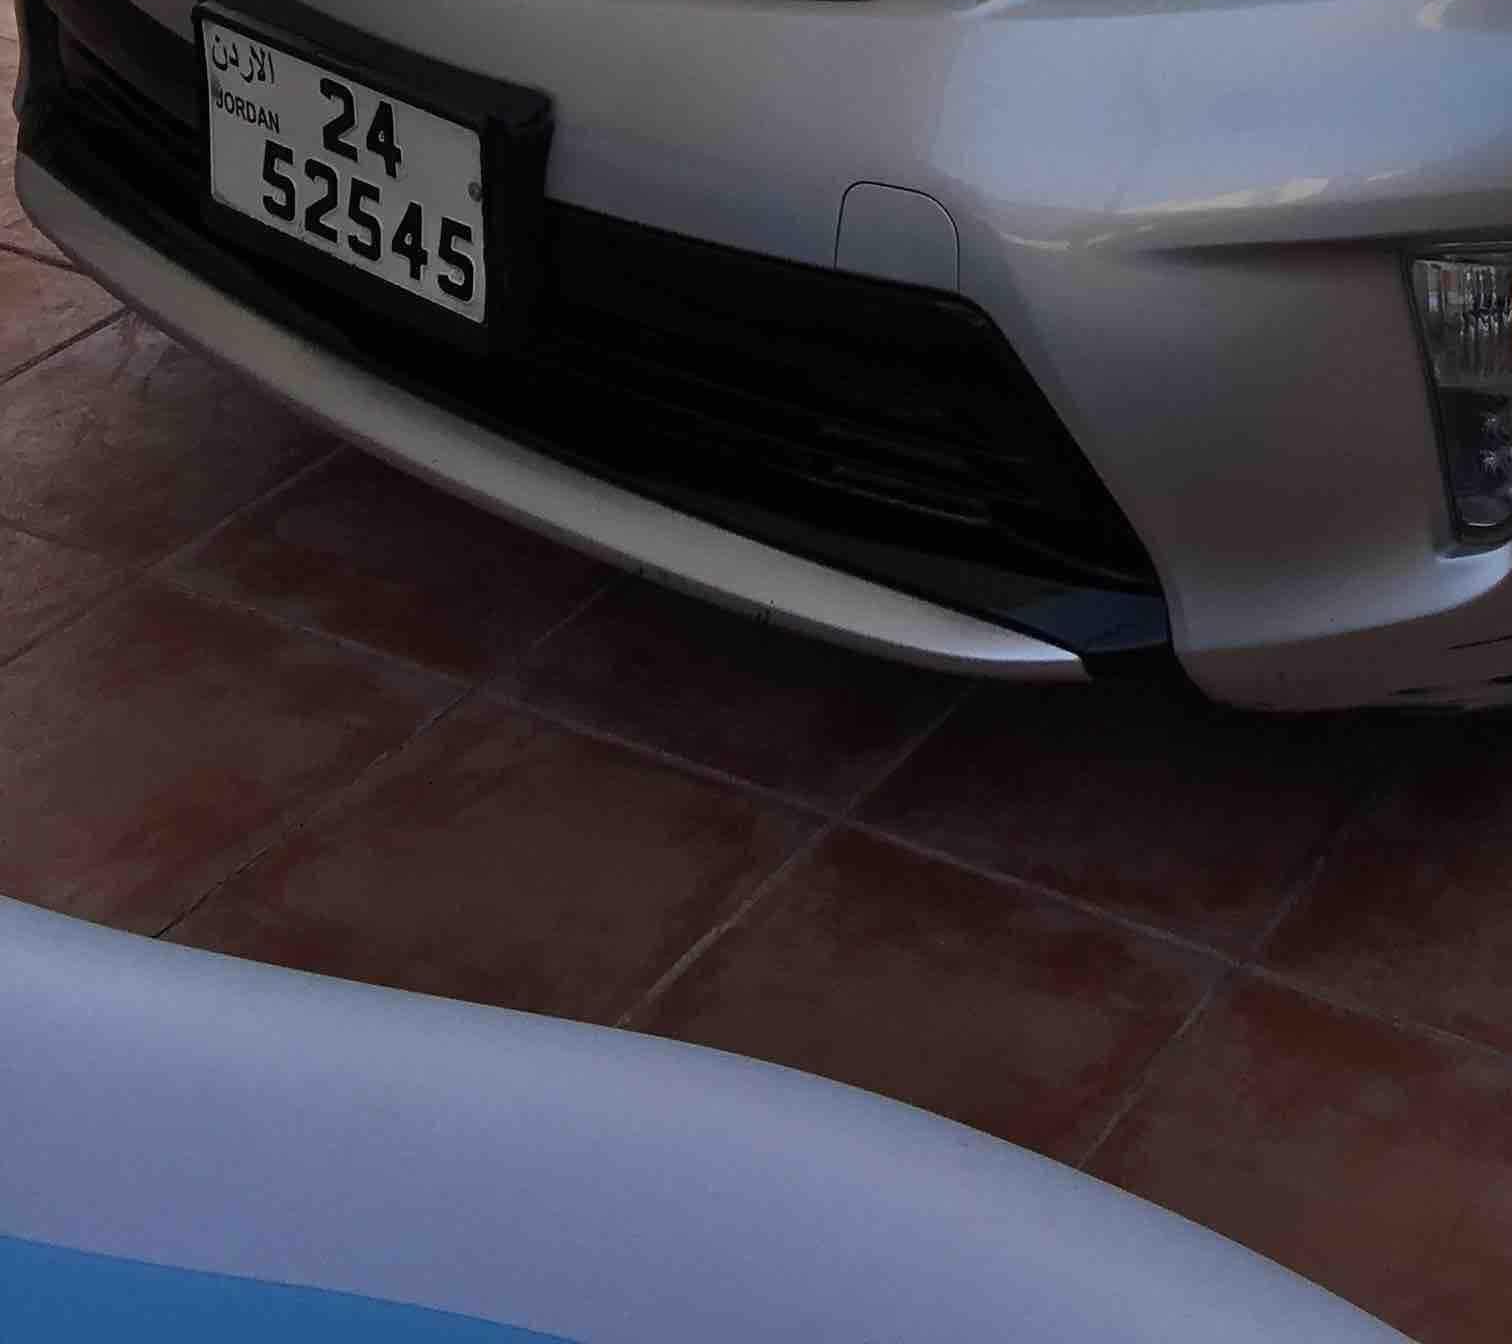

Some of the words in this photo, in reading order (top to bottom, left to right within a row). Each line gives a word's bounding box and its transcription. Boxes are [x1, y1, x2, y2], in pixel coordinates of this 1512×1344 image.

[215, 88, 280, 134] JORDAN
[320, 78, 402, 179] 24
[262, 139, 475, 302] 52545
